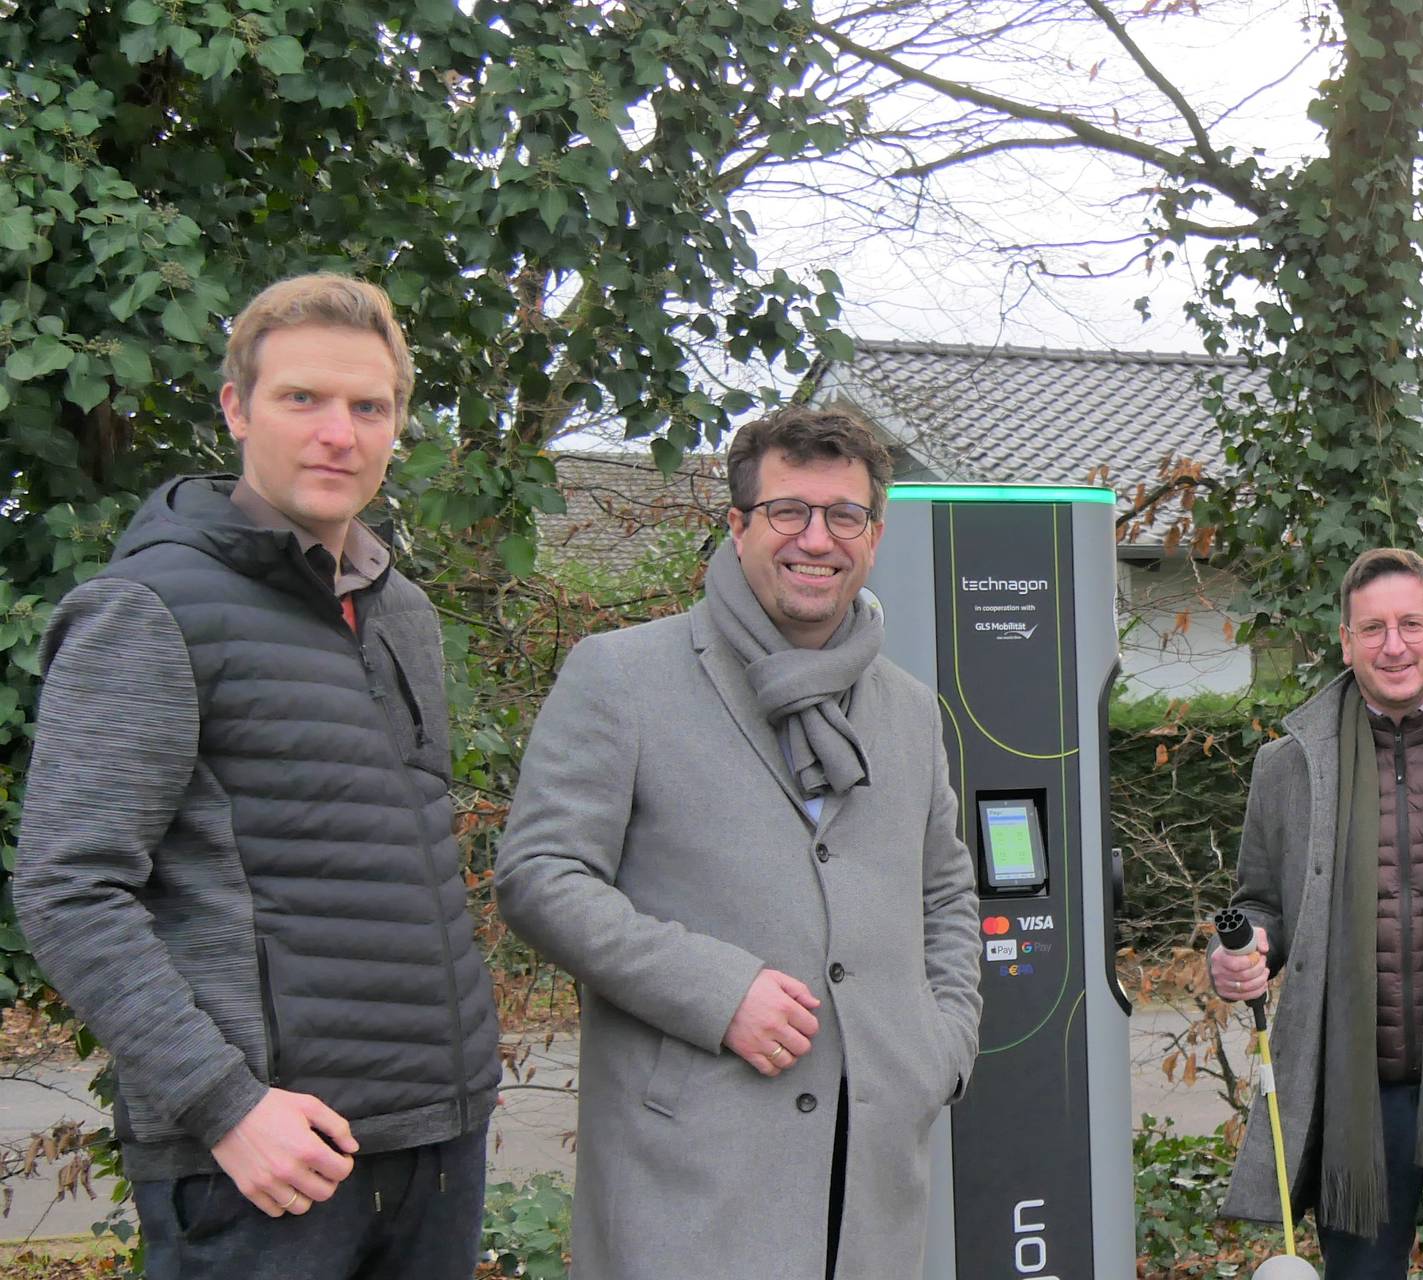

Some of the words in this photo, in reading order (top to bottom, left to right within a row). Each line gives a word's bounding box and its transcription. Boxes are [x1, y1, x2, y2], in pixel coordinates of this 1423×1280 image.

[962, 576, 1048, 595] technagon
[975, 622, 991, 631] GLS
[1016, 914, 1054, 931] VISA
[997, 945, 1013, 956] Pay
